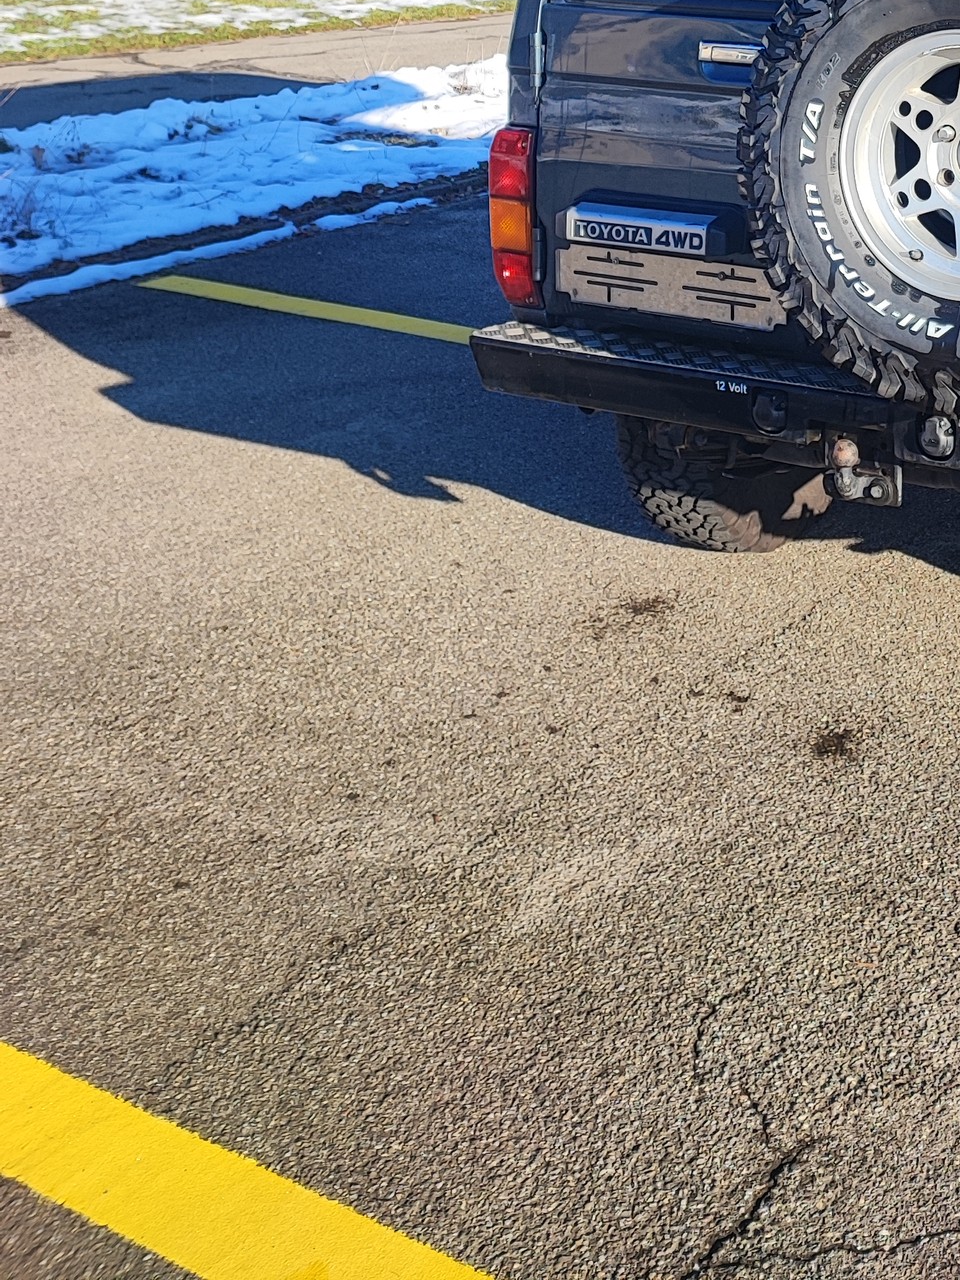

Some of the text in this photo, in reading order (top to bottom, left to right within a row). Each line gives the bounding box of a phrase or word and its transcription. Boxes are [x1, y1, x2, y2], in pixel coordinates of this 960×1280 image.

[800, 102, 824, 161] T/A
[576, 221, 704, 251] TOYOTA 4WD
[804, 183, 954, 339] All-Terrain
[715, 380, 748, 395] 12 Volt
